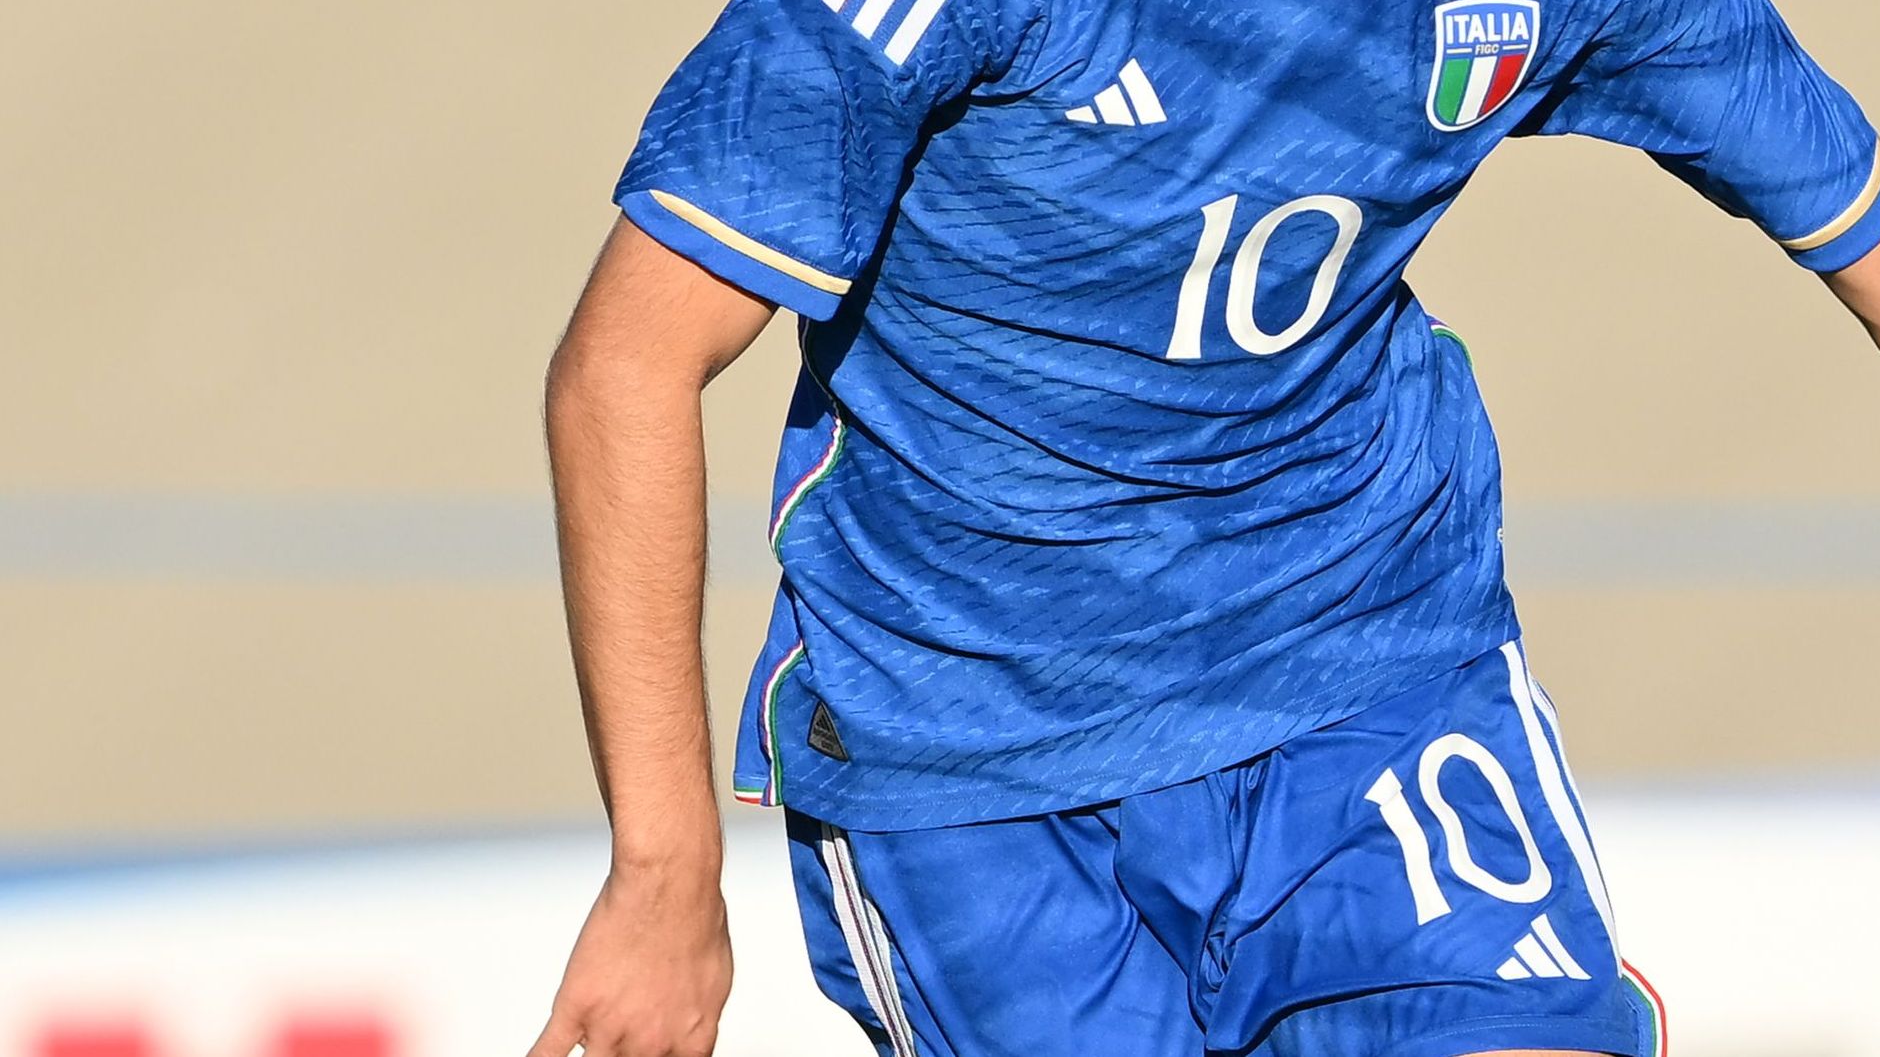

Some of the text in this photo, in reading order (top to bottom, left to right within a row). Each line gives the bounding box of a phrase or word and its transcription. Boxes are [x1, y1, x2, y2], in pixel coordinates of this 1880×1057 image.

[1445, 11, 1530, 45] ITALIA
[1474, 43, 1500, 56] FIGC
[1165, 193, 1363, 360] 10
[1363, 732, 1553, 926] 10
